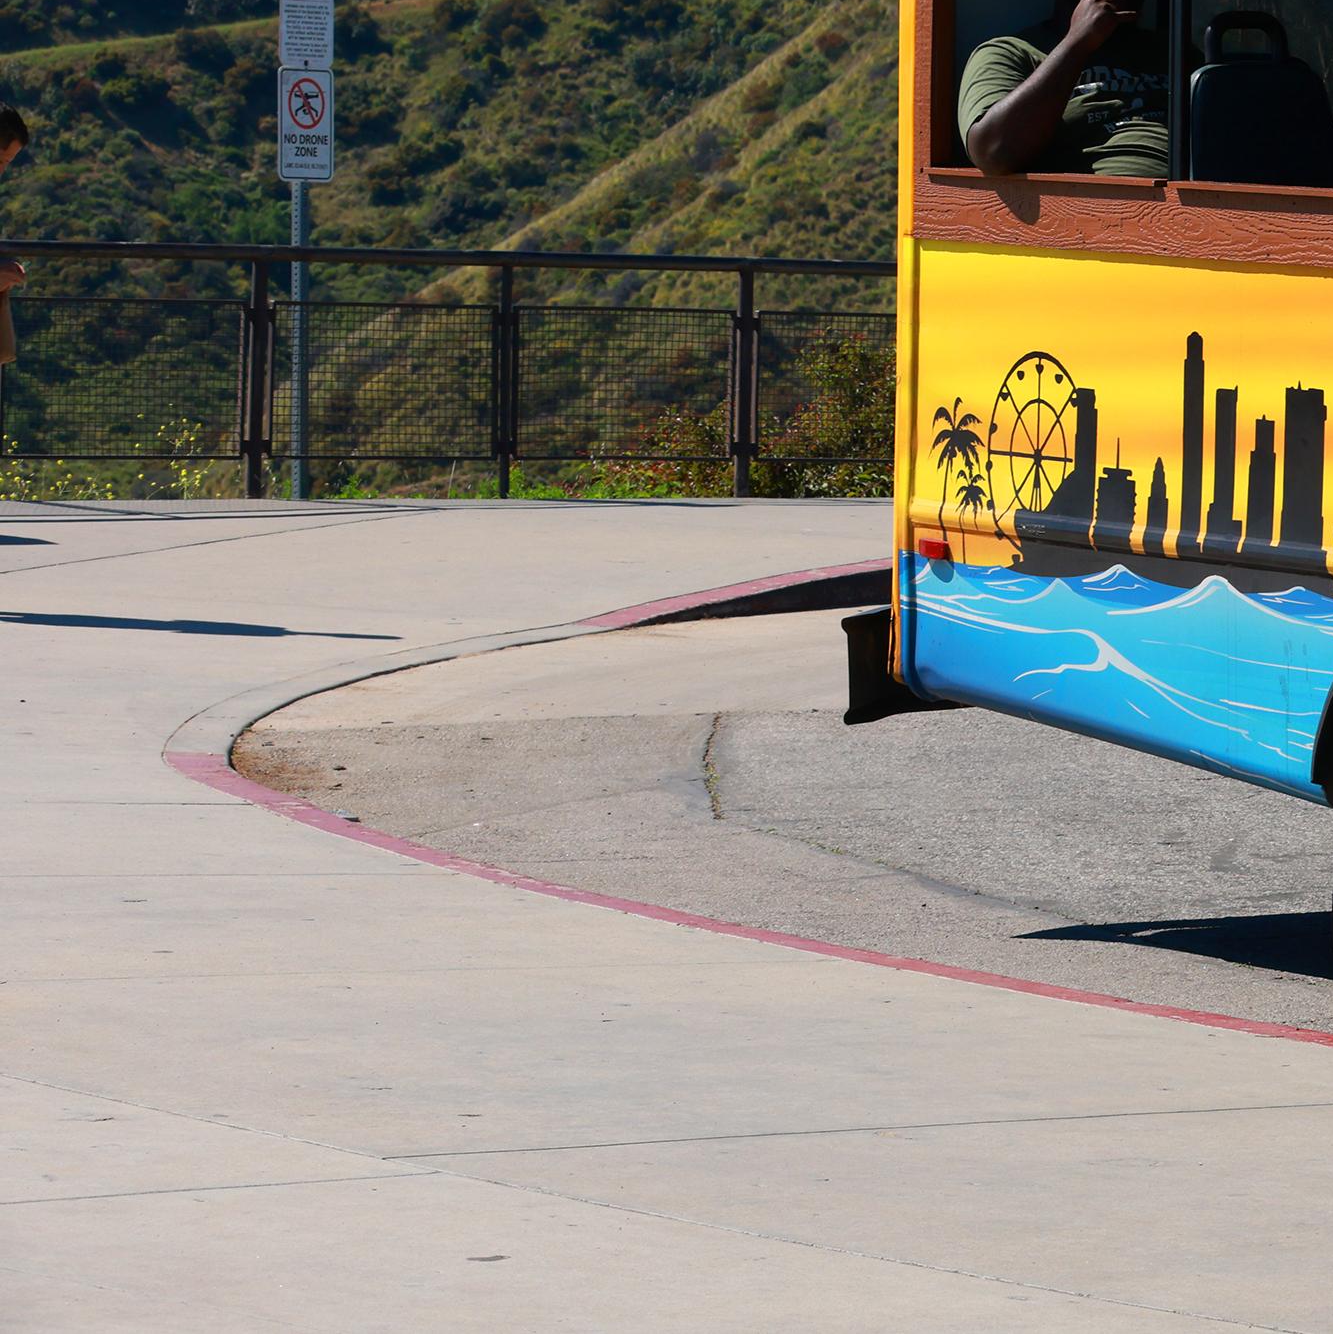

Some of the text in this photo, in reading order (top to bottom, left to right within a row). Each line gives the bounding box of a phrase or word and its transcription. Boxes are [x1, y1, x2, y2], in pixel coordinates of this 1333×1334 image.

[284, 134, 328, 146] NO DRONE
[294, 146, 318, 158] ZONE
